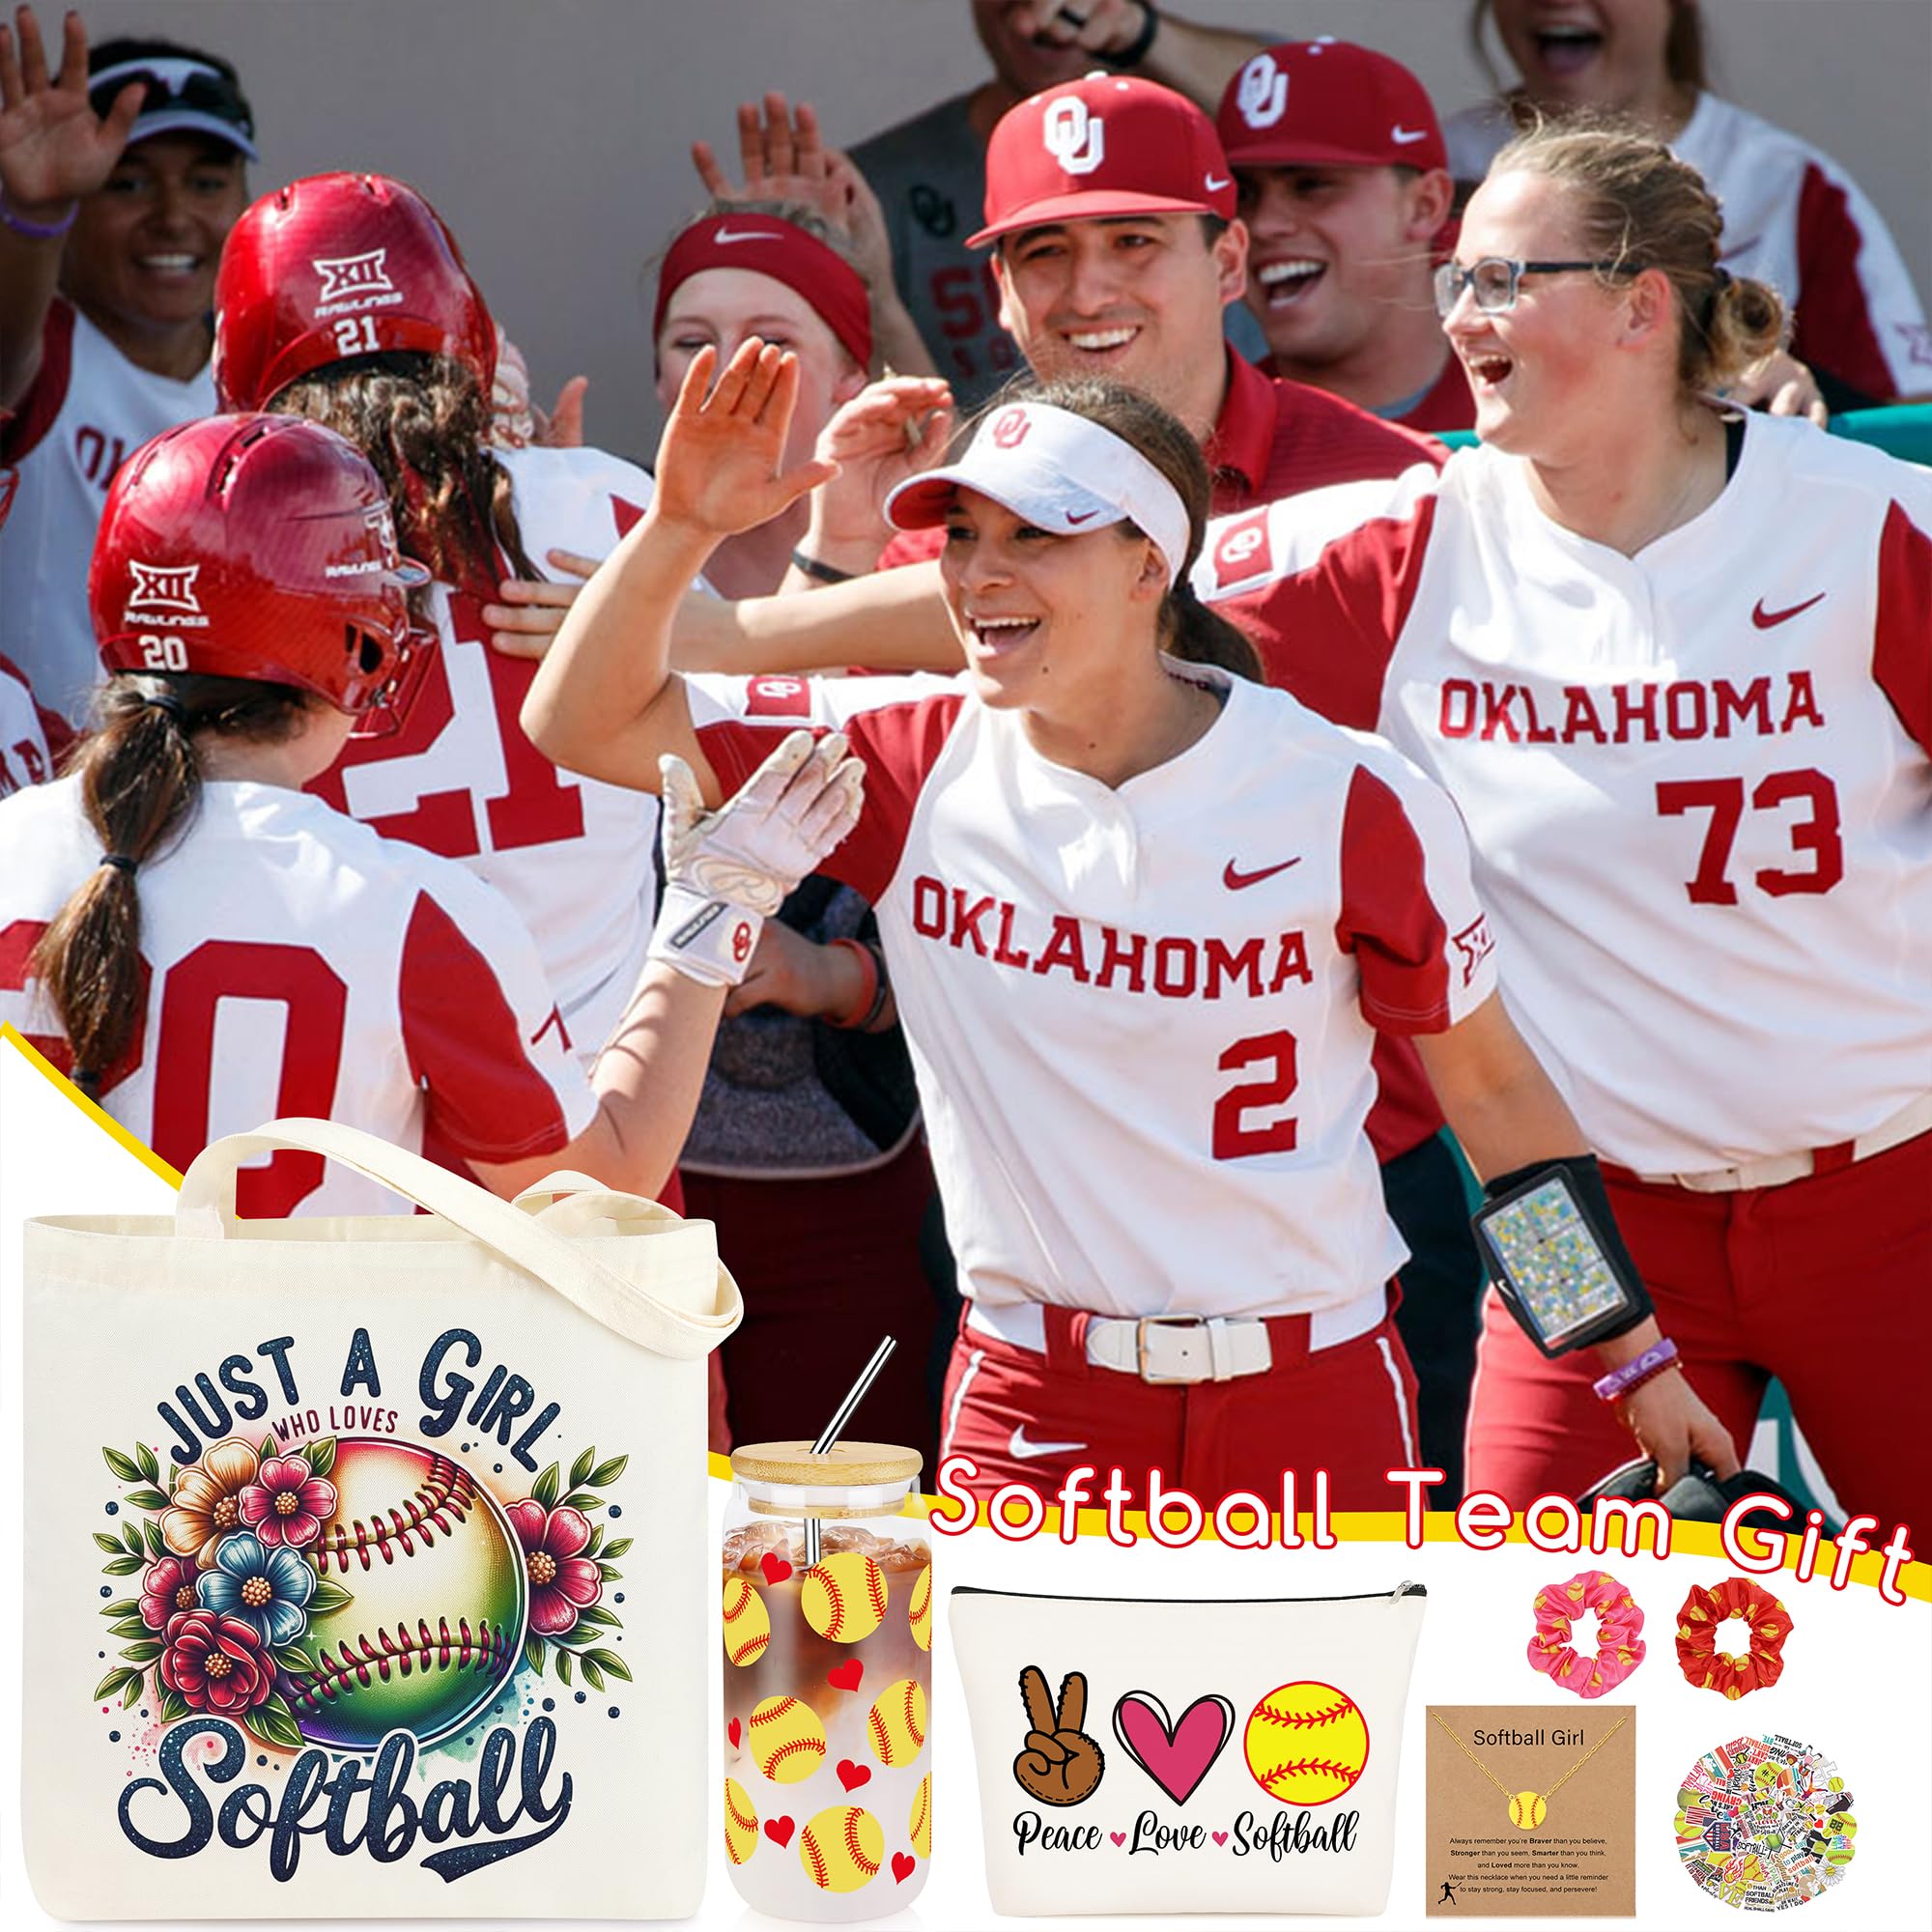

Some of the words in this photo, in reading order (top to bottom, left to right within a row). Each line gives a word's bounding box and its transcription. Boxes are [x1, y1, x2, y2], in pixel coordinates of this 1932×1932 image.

[1043, 95, 1105, 175] OU
[334, 316, 380, 356] 21
[139, 635, 188, 671] 20
[1438, 670, 1826, 744] OKLAHOMA
[1655, 768, 1844, 905] 73
[912, 874, 1314, 1001] OKLAHOMA
[1211, 1029, 1299, 1160] 2
[156, 1335, 299, 1465] JUST
[340, 1327, 382, 1398] A
[418, 1327, 561, 1473] GIRL
[271, 1419, 320, 1442] WHO
[329, 1406, 399, 1434] LOVES
[1473, 1728, 1545, 1747] Softball
[1551, 1728, 1584, 1747] Girl
[117, 1715, 573, 1884] Softball
[1711, 1790, 1743, 1805] CRYING
[1012, 1810, 1103, 1857] Peace
[1128, 1809, 1208, 1857] Love
[1232, 1809, 1360, 1863] Softball
[1450, 1849, 1481, 1858] Stronger
[1508, 1837, 1528, 1846] you're
[1720, 1824, 1730, 1850] USA
[1787, 1855, 1815, 1874] softball
[1790, 1851, 1804, 1863] play
[1563, 1886, 1598, 1894] persevere!
